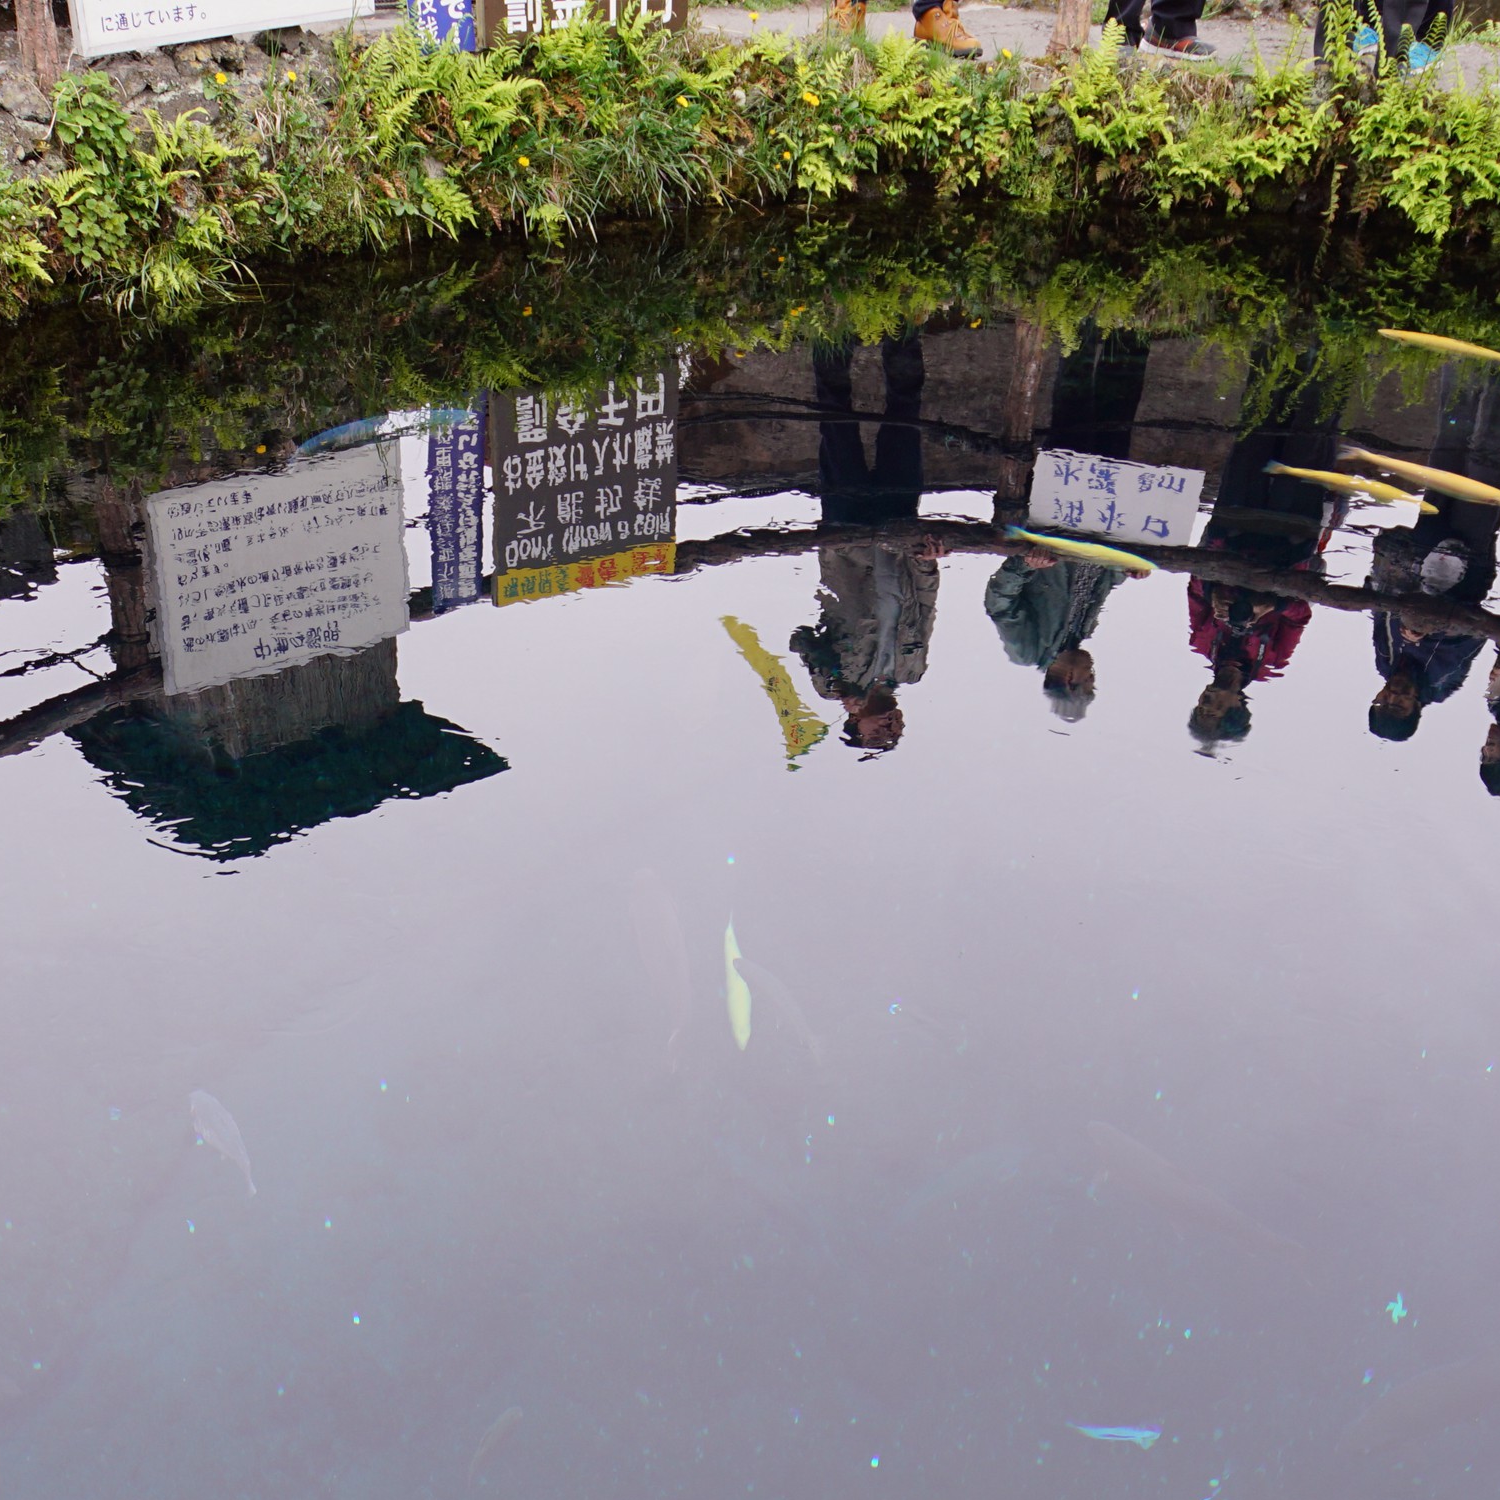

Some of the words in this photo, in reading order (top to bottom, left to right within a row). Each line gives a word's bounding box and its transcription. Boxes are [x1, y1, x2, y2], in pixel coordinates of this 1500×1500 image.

[100, 3, 208, 33] に通じています。
